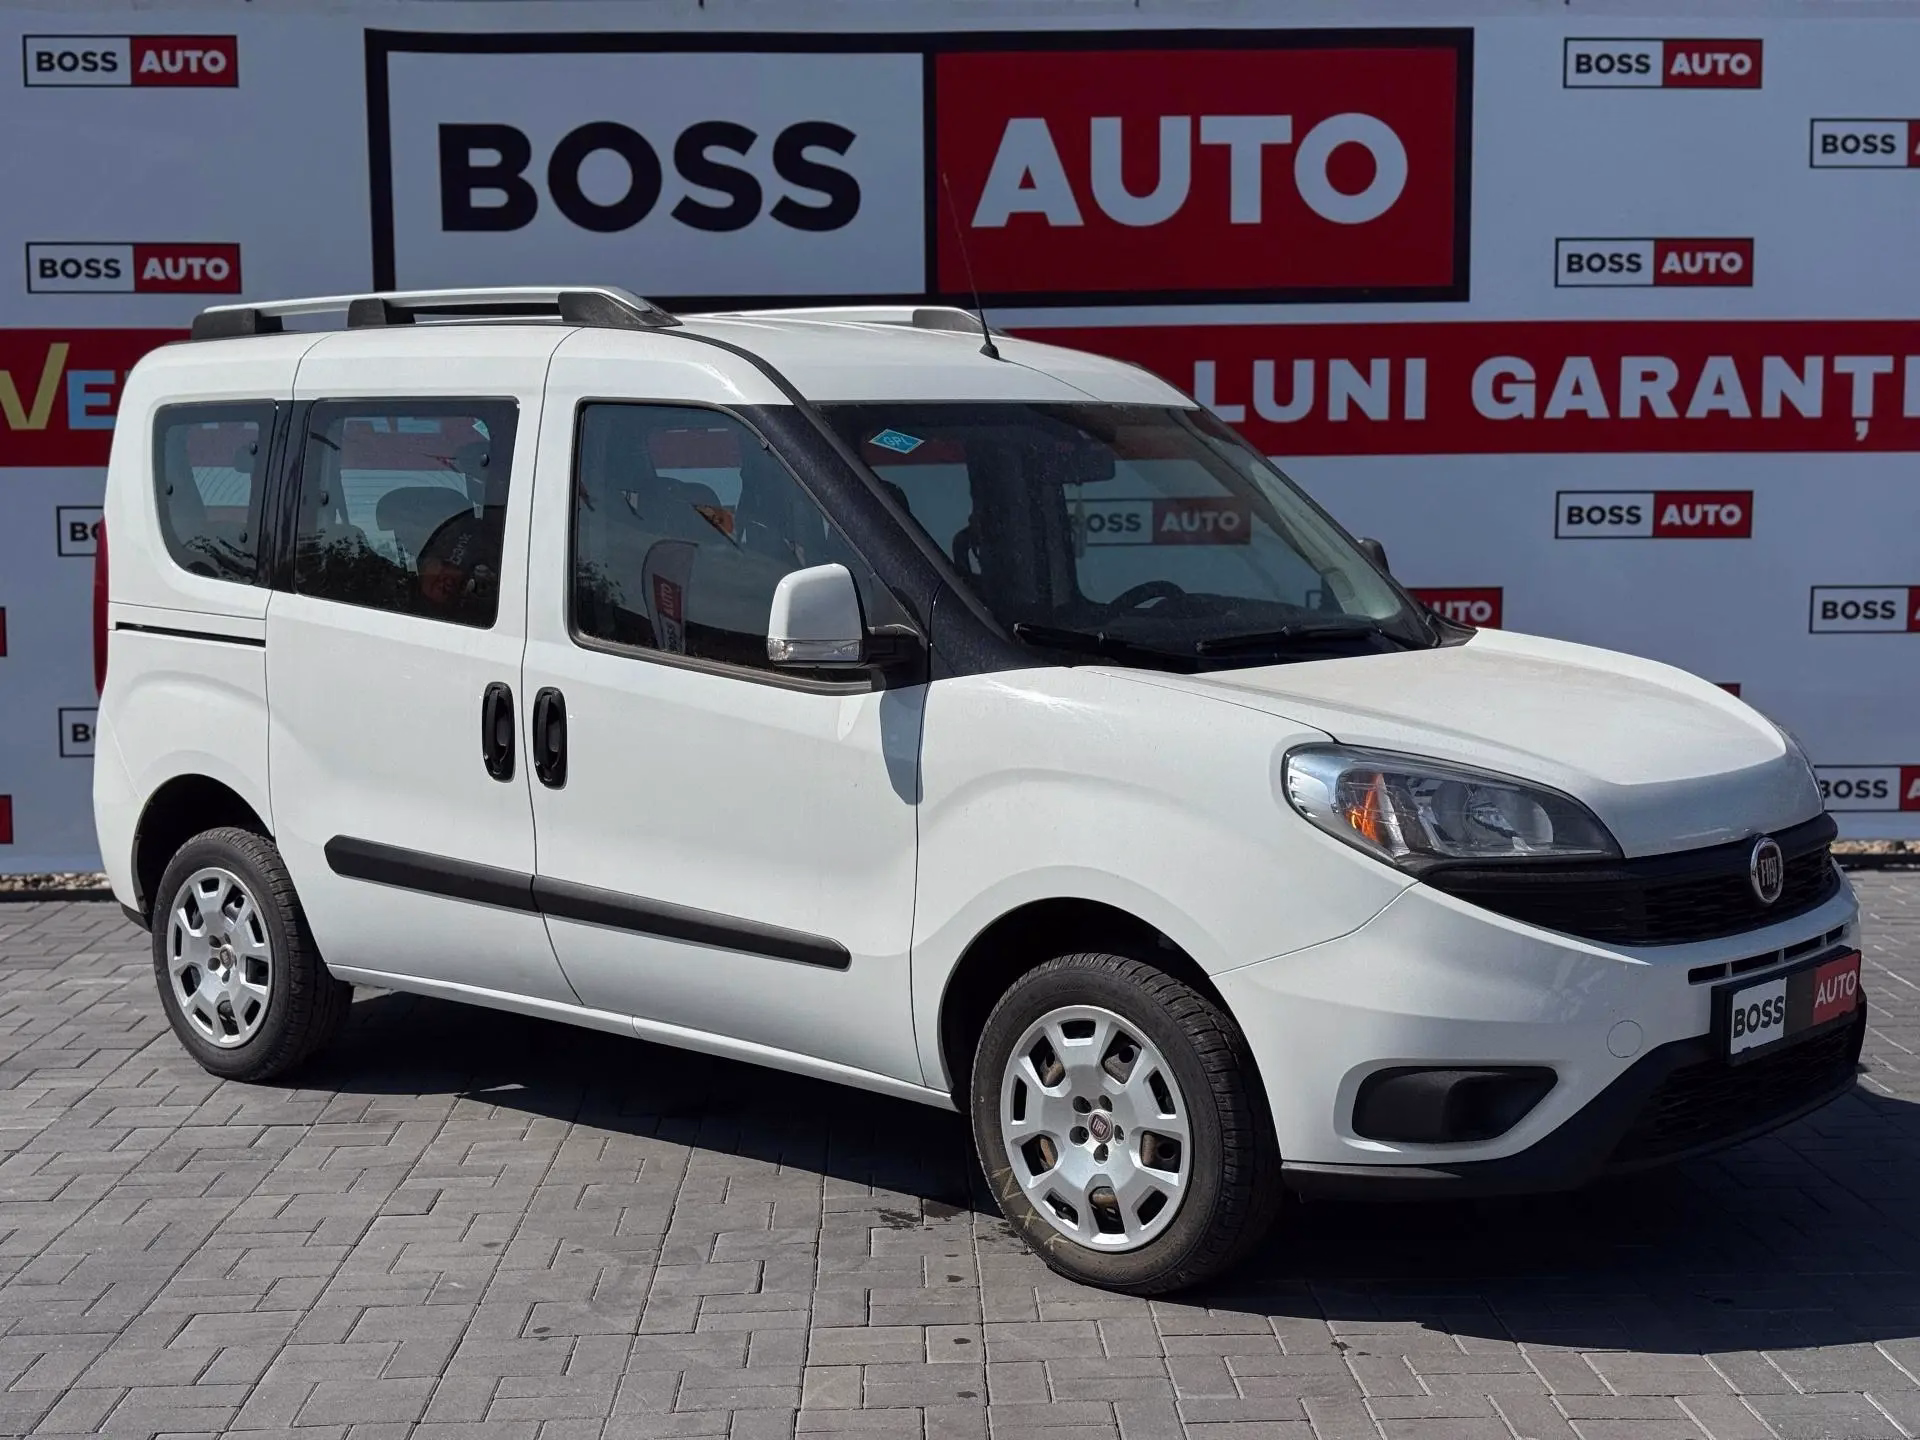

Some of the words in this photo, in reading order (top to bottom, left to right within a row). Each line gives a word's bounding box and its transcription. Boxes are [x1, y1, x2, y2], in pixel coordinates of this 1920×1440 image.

[35, 51, 118, 73] BOSS
[139, 49, 227, 74] AUTO
[1575, 53, 1651, 74] BOSS
[1670, 52, 1752, 75] AUTO
[1821, 134, 1897, 155] BOSS
[438, 121, 861, 233] BOSS
[971, 112, 1409, 228] AUTO
[39, 257, 122, 280] BOSS
[142, 257, 230, 281] AUTO
[1566, 253, 1643, 274] BOSS
[1661, 251, 1743, 274] AUTO
[1193, 357, 1427, 423] LUNI
[1160, 510, 1244, 532] AUTO
[1566, 505, 1642, 526] BOSS
[1660, 503, 1742, 526] AUTO
[1821, 600, 1897, 621] BOSS
[1732, 995, 1785, 1038] BOSS
[1815, 970, 1856, 1008] AUTO
